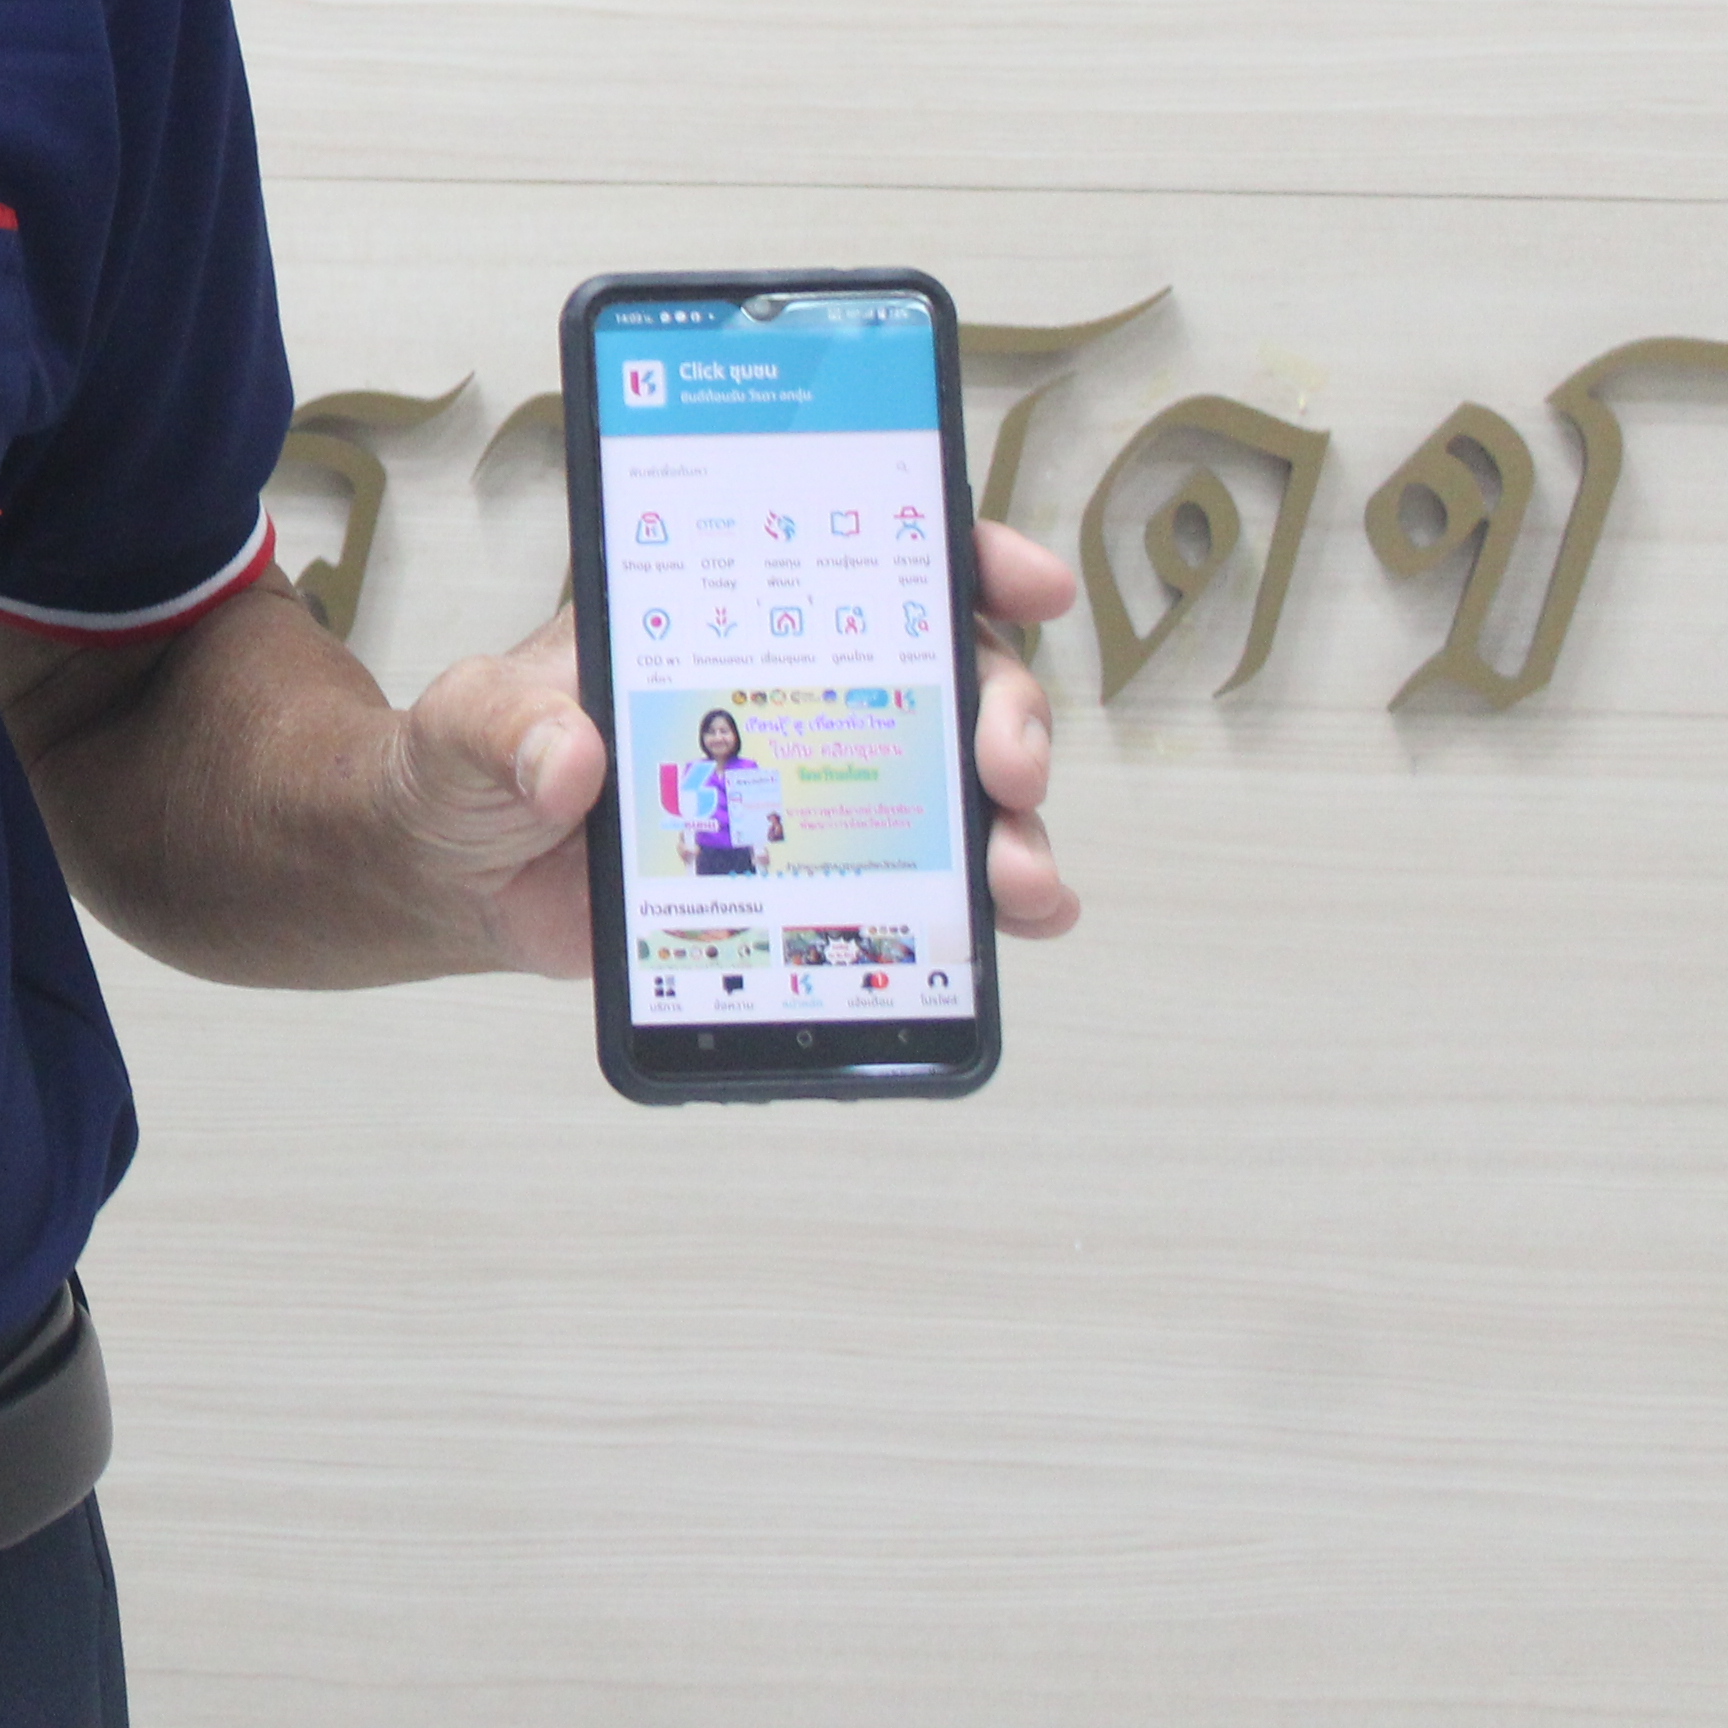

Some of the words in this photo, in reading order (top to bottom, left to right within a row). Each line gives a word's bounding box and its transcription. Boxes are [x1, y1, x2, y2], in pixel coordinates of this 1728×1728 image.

[679, 361, 726, 381] Click
[622, 559, 652, 572] Shop
[701, 558, 735, 569] OTOP
[701, 577, 738, 590] Today
